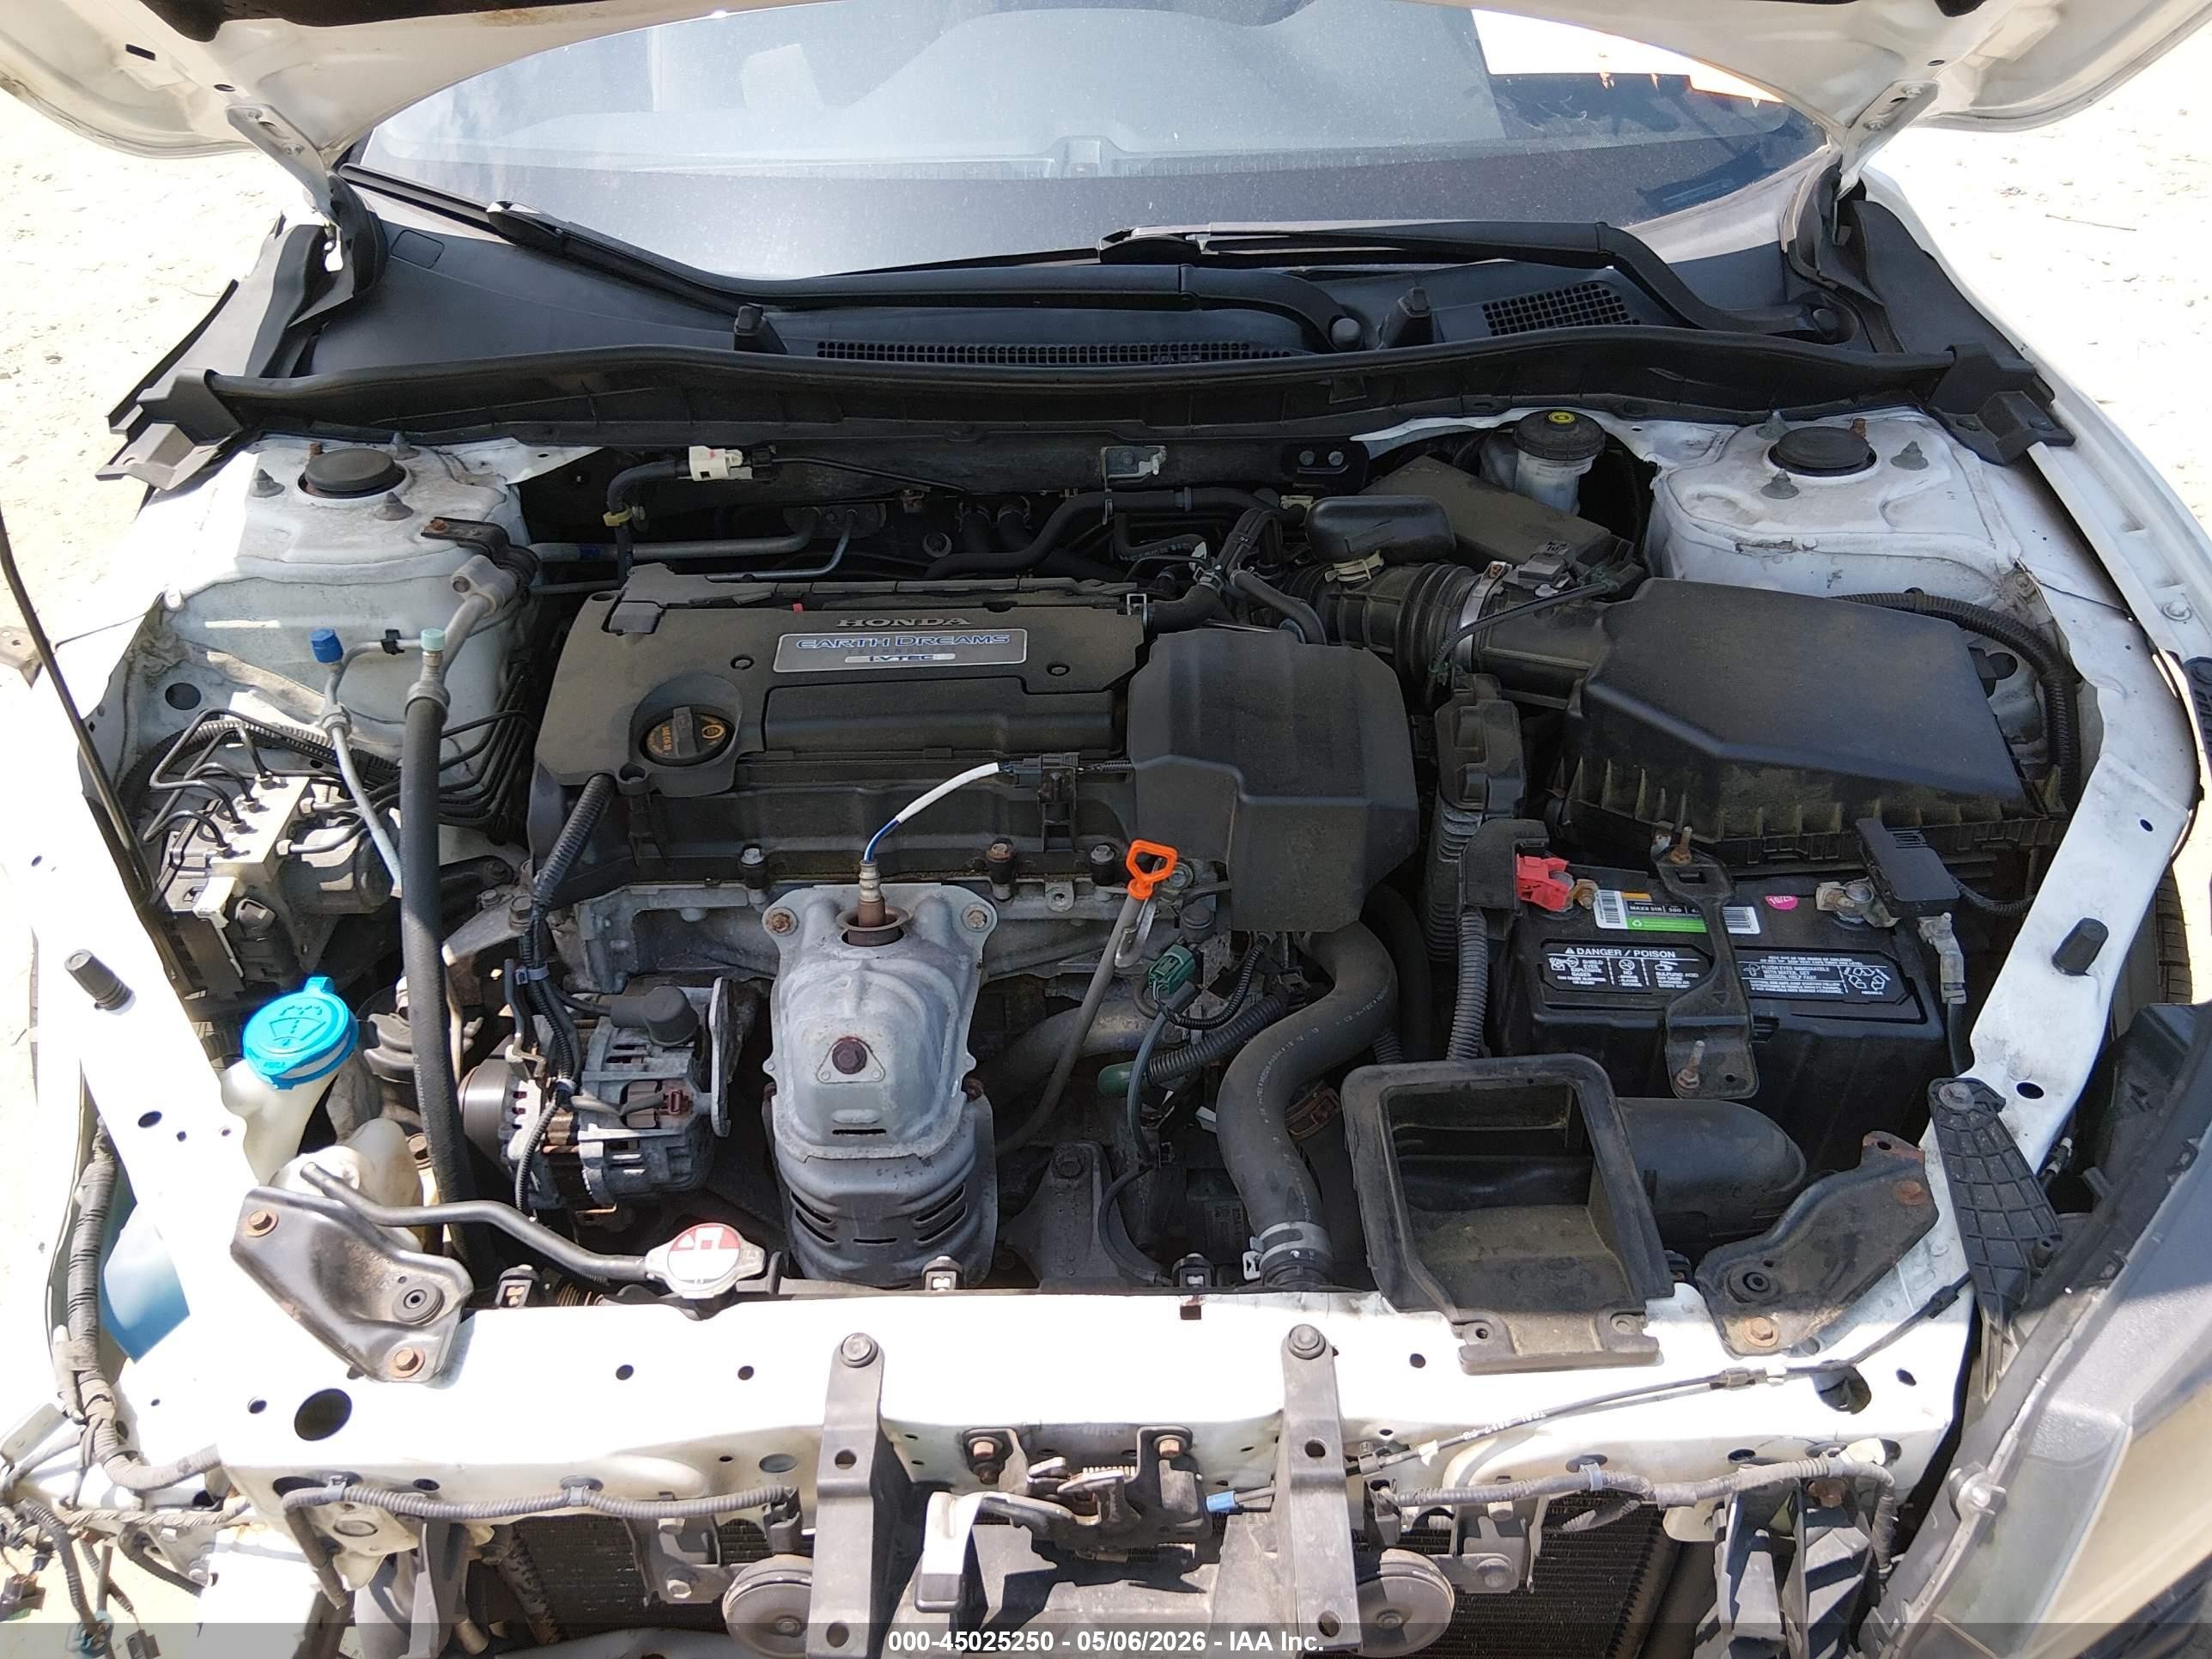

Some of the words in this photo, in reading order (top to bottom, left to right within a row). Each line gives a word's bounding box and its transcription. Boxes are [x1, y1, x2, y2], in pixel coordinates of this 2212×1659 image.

[836, 617, 971, 628] HONDA
[796, 637, 890, 649] EARTH
[895, 634, 1011, 647] DREAMS
[1577, 947, 1622, 957] DANGER
